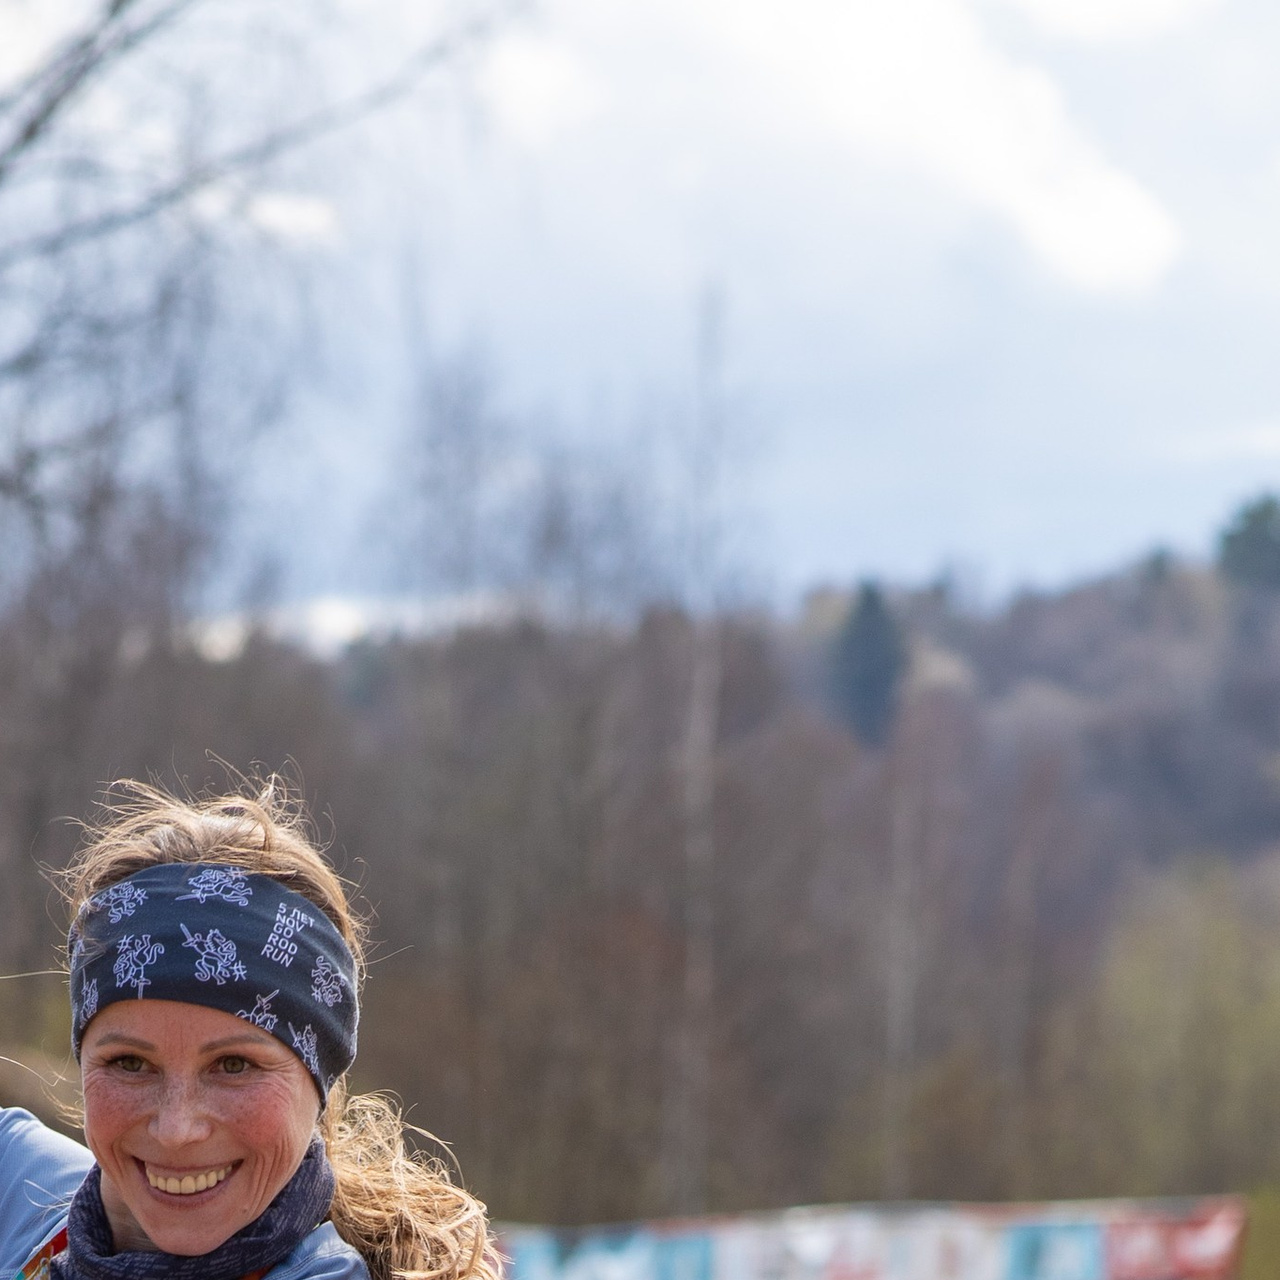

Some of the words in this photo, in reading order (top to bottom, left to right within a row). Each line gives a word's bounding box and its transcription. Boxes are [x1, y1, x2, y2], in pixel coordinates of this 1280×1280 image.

[276, 913, 305, 932] NOV
[278, 902, 287, 914] 5
[290, 908, 315, 927] ЛЕТ
[273, 922, 293, 938] GO
[267, 933, 298, 955] ROD
[261, 944, 293, 967] RUN
